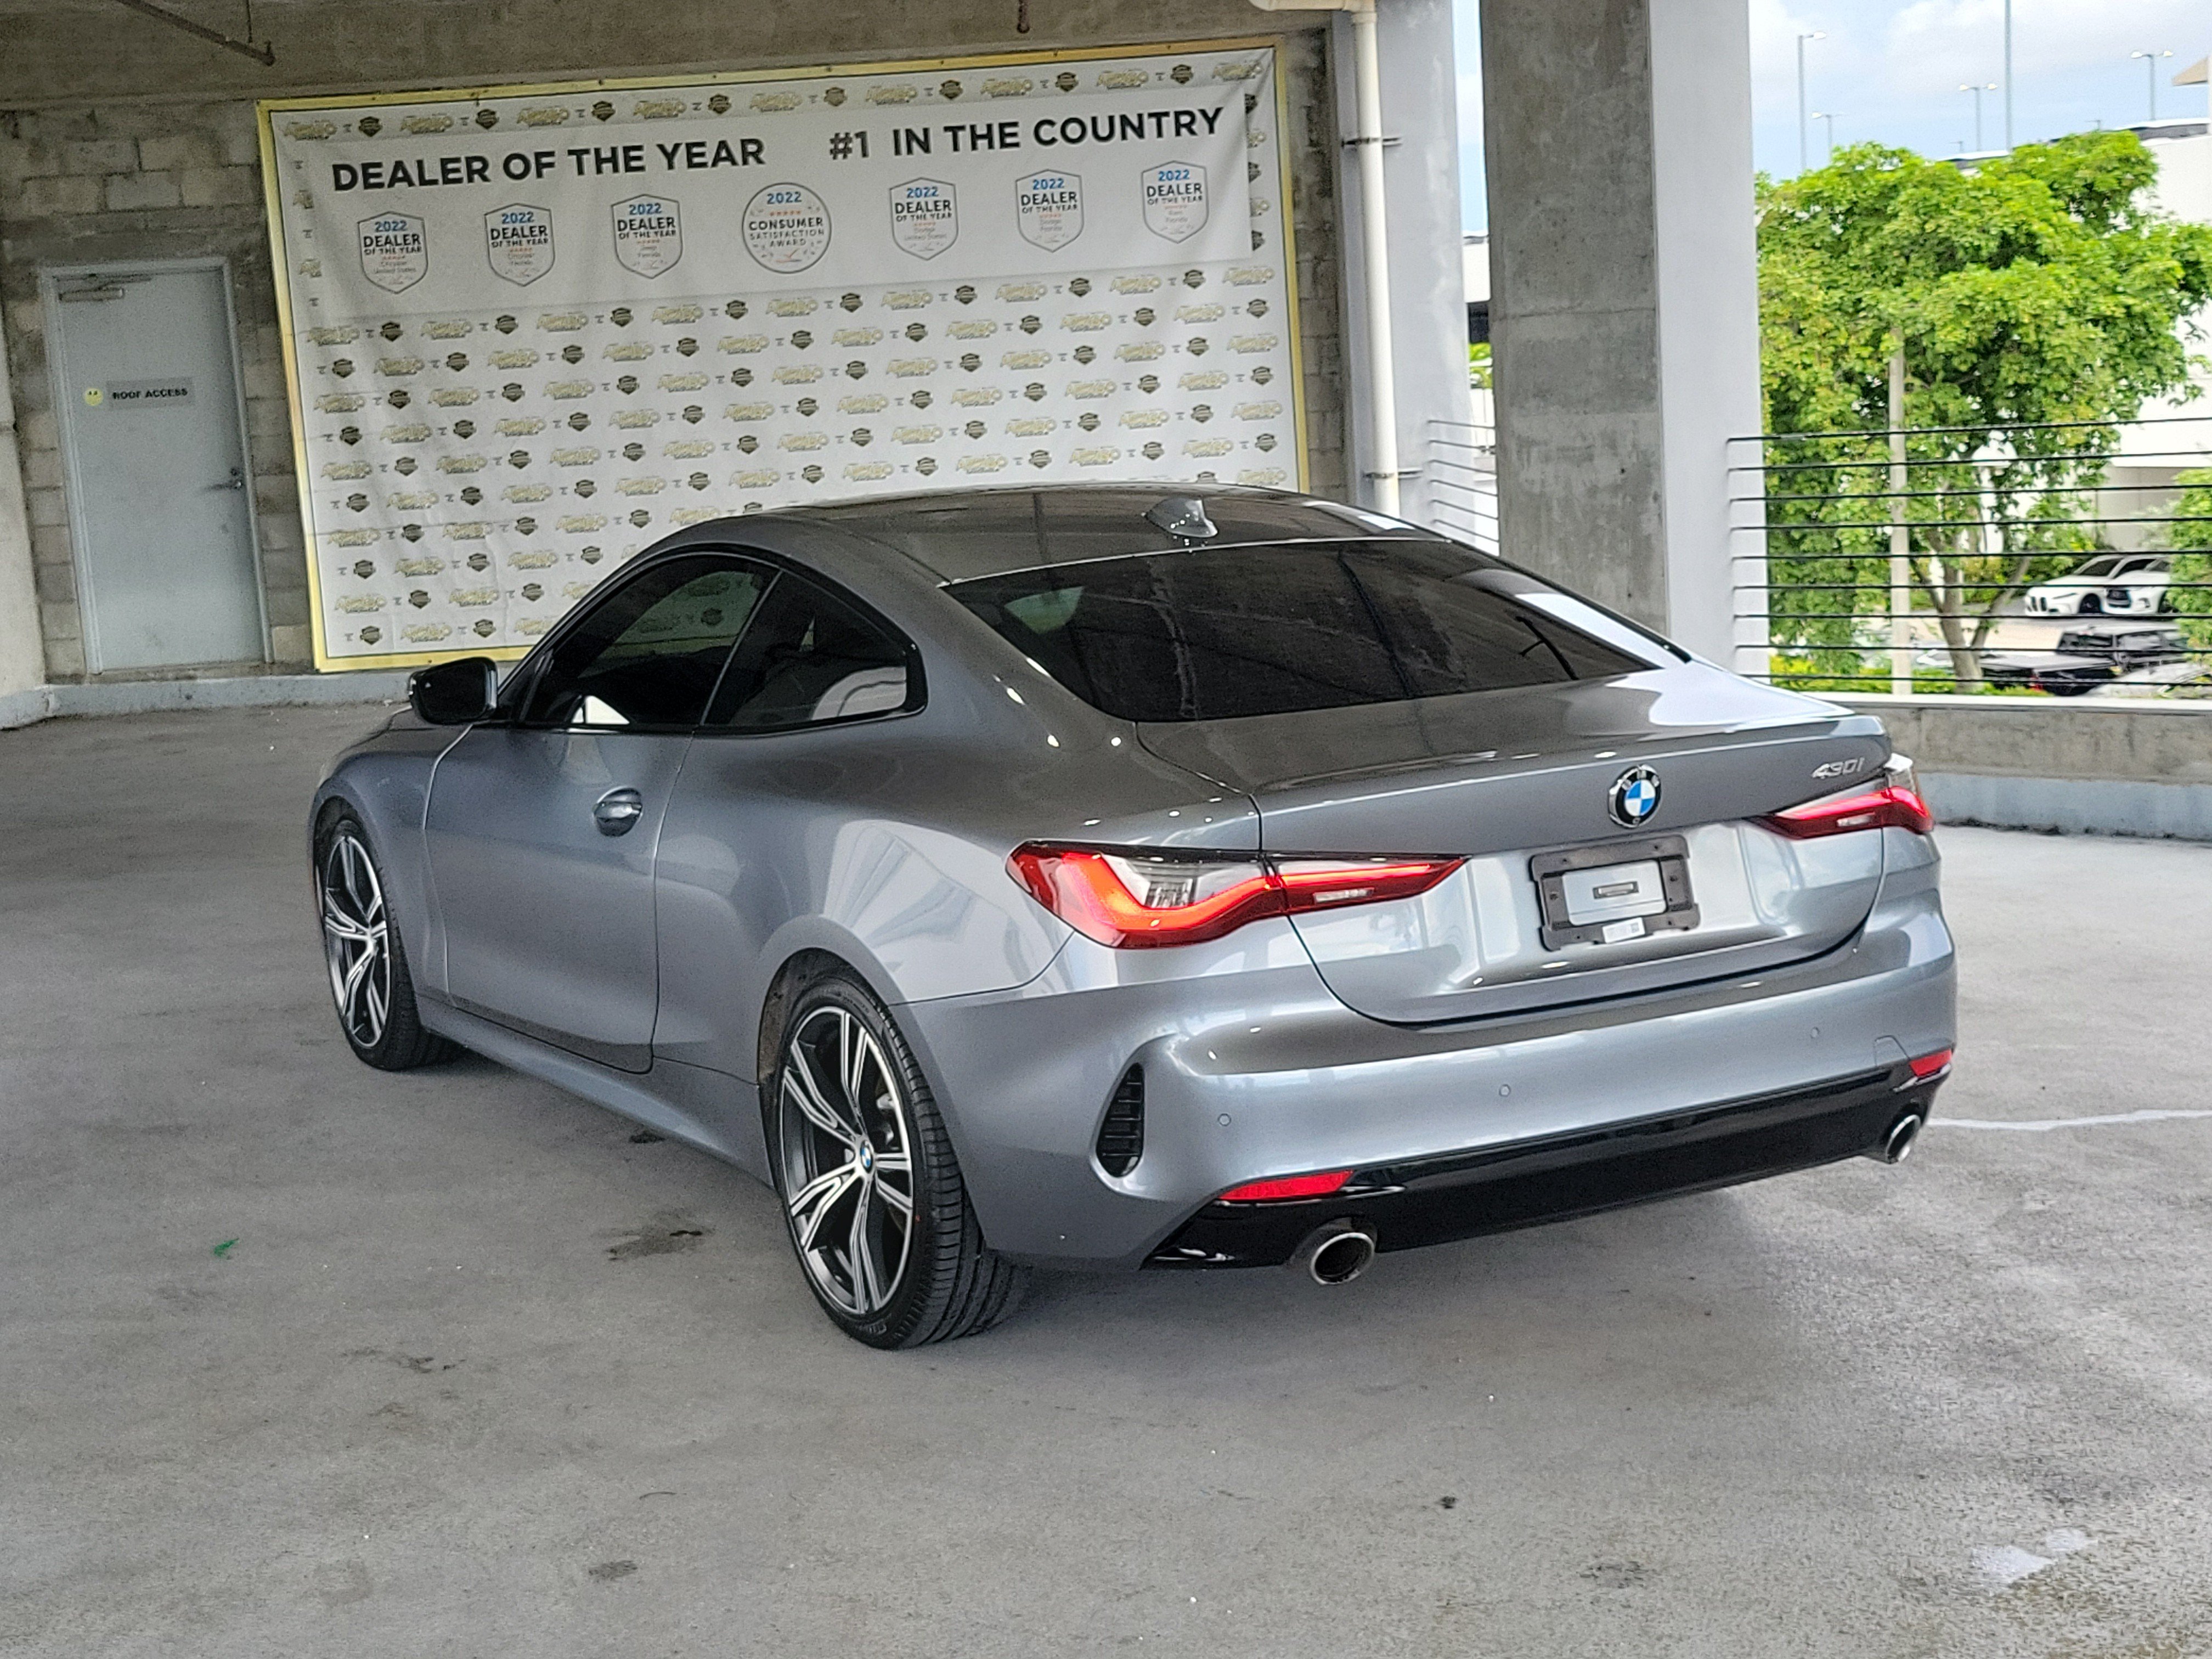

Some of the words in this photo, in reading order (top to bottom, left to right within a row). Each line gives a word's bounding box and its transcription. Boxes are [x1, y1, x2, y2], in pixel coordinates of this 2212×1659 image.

[829, 131, 870, 160] #1
[893, 127, 932, 156] IN
[943, 121, 1020, 152] THE
[1033, 106, 1224, 146] COUNTRY
[333, 155, 491, 191] DEALER
[503, 150, 556, 180] OF
[567, 145, 646, 176] THE
[656, 138, 766, 170] YEAR
[1158, 169, 1190, 181] 2022
[1032, 178, 1065, 190] 2022
[1147, 183, 1203, 198] DEALER
[767, 191, 802, 204] 2022
[906, 186, 939, 199] 2022
[1020, 191, 1077, 206] DEALER
[629, 203, 662, 215] 2022
[895, 200, 952, 214] DEALER
[501, 212, 534, 224] 2022
[618, 217, 676, 231] DEALER
[749, 217, 823, 230] CONSUMER
[375, 221, 407, 232] 2022
[490, 225, 548, 240] DEALER
[363, 234, 421, 247] DEALER
[749, 229, 825, 240] SATISFACTION
[770, 239, 806, 247] AWARD
[145, 388, 188, 398] ACCESS
